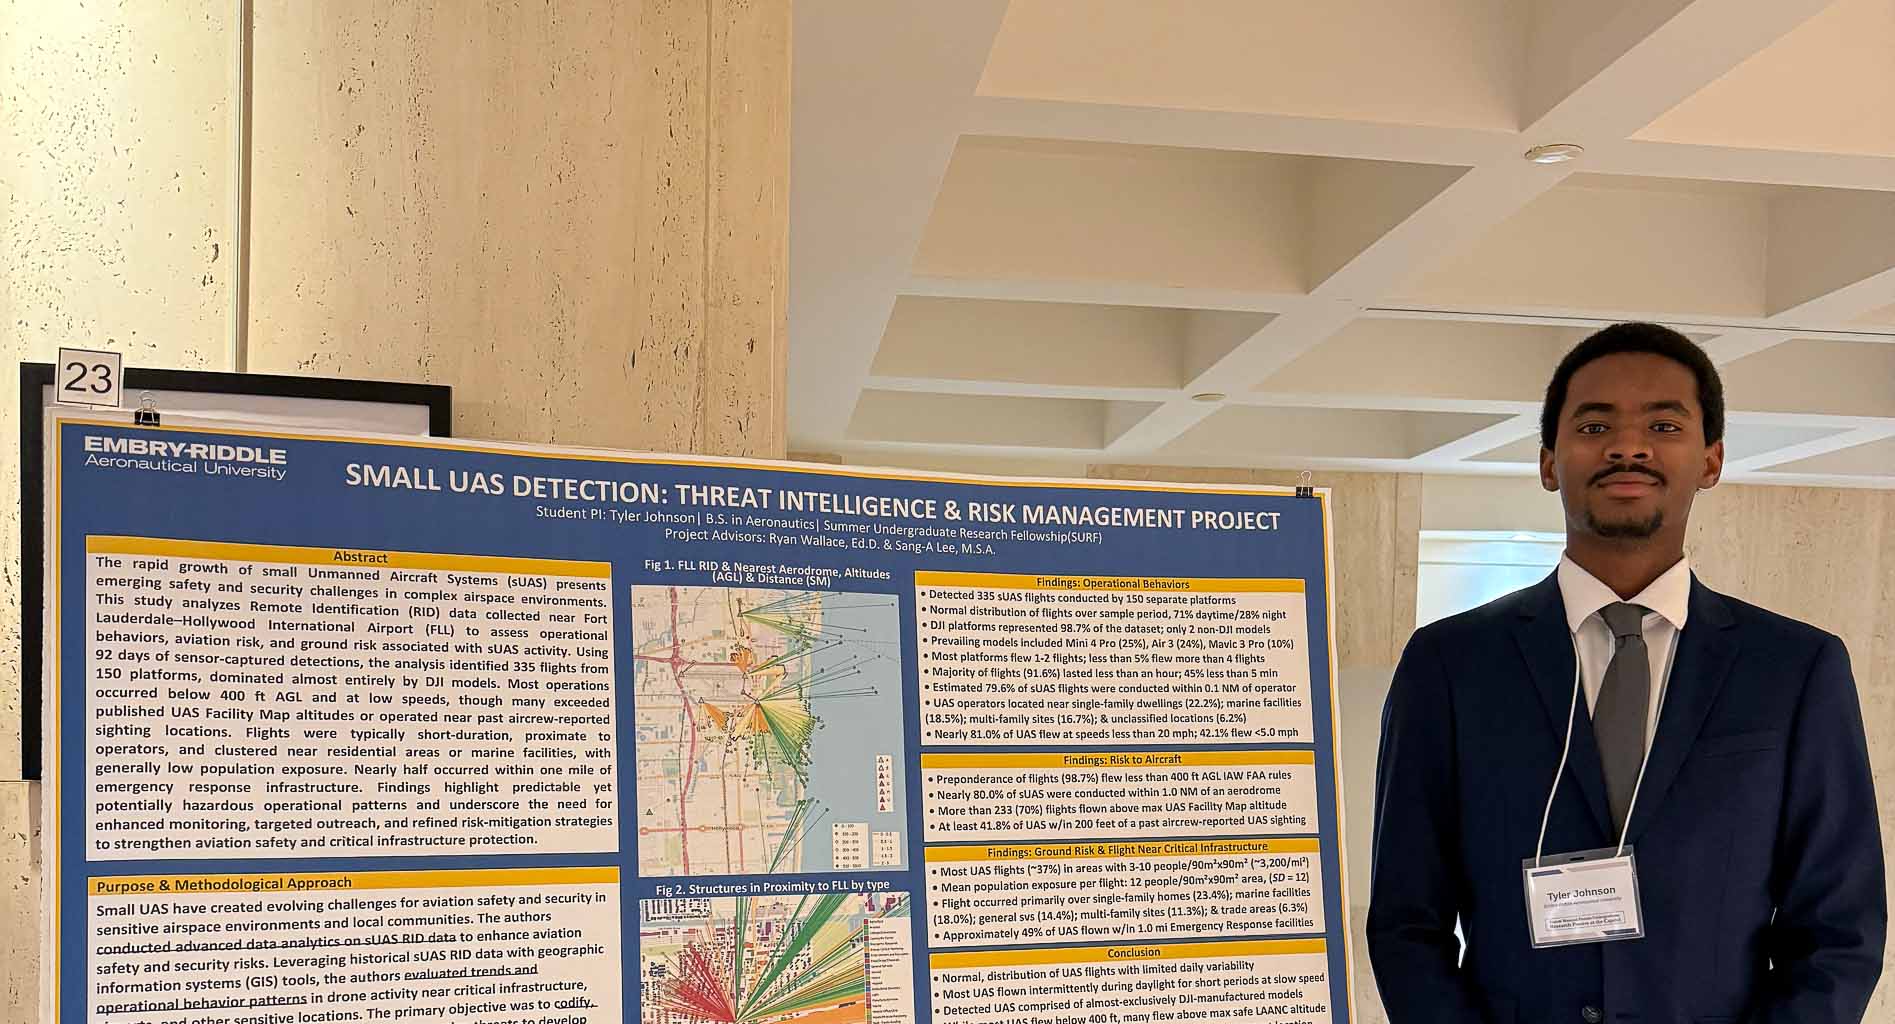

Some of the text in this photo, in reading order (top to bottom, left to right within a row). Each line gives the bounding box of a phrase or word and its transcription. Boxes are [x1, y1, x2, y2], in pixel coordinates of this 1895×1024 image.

[64, 362, 112, 394] 23
[84, 436, 287, 464] EMBRY-RIDDLE
[84, 454, 286, 480] Aeronautical University
[346, 463, 1280, 529] SMALL UAS DETECTION: THREAT INTELLIGENCE & RISK MANAGEMENT PROJECT
[536, 505, 586, 519] Student
[590, 508, 605, 519] PI:
[609, 509, 640, 523] Tyler
[706, 513, 727, 524] B.S.
[731, 513, 742, 525] in
[823, 519, 870, 533] Summer
[873, 523, 956, 537] Undergraduate
[959, 527, 1007, 539] Research
[1010, 529, 1102, 544] Fellowship(SURF)
[665, 527, 995, 554] Project Advisors: Ryan Wallace, Ed.D. & Sang-A Lee, M.S.A.
[333, 550, 387, 563] Abstract
[95, 555, 606, 591] The rapid growth of small Unmanned Aircraft Systems (sUAS) presents
[645, 559, 890, 579] Fig 1. FLL RID & Nearest Aerodrome, Altitudes
[713, 572, 831, 588] (AGL) & Distance (SM)
[1036, 577, 1189, 589] Findings: Operational Behaviors
[96, 576, 606, 607] emerging safety and security challenges in complex airspace environments.
[929, 589, 1236, 606] Detected 335 sUAS flights conducted by 150 separate platforms
[1063, 753, 1181, 766] Findings: Risk to Aircraft
[987, 842, 1267, 859] Findings: Ground Risk & Flight Near Critical Infrastructure
[97, 876, 351, 894] Purpose & Methodological Approach
[656, 879, 889, 897] Fig 2. Structures in Proximity to FLL by type
[1547, 887, 1616, 902] Tyler Johnson
[96, 891, 605, 916] Small UAS have created evolving challenges for aviation safety and security in
[1107, 947, 1160, 958] Conclusion
